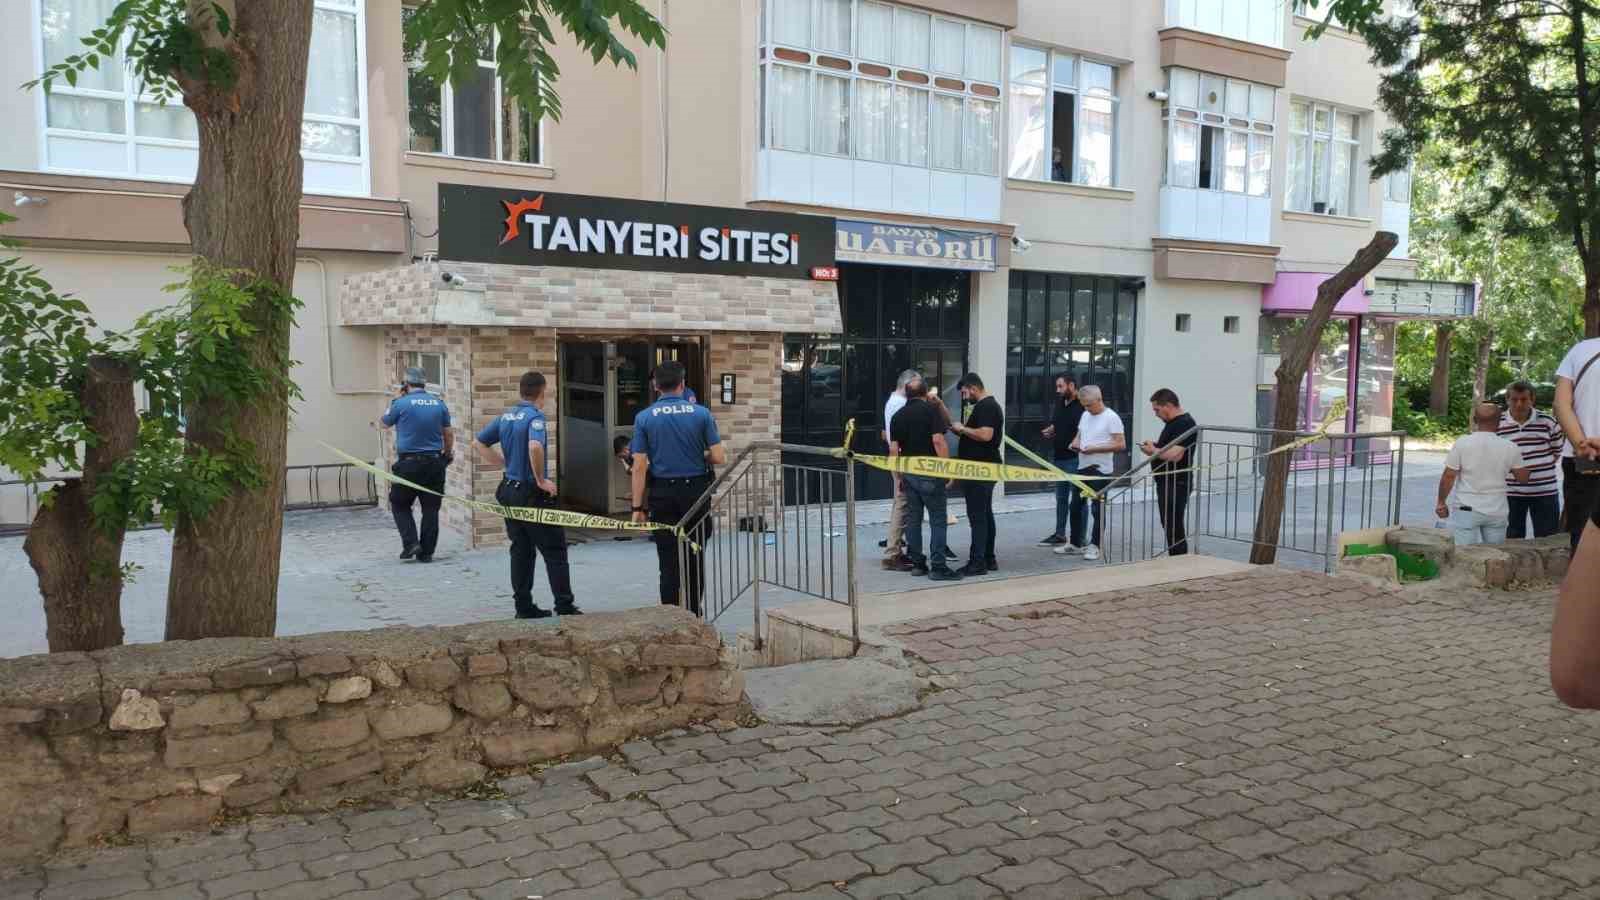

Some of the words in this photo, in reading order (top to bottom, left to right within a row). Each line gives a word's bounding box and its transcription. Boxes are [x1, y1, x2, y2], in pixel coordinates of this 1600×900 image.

[525, 214, 689, 258] TANYERİ
[700, 225, 799, 265] SİTESİ
[872, 225, 938, 240] BAYAN
